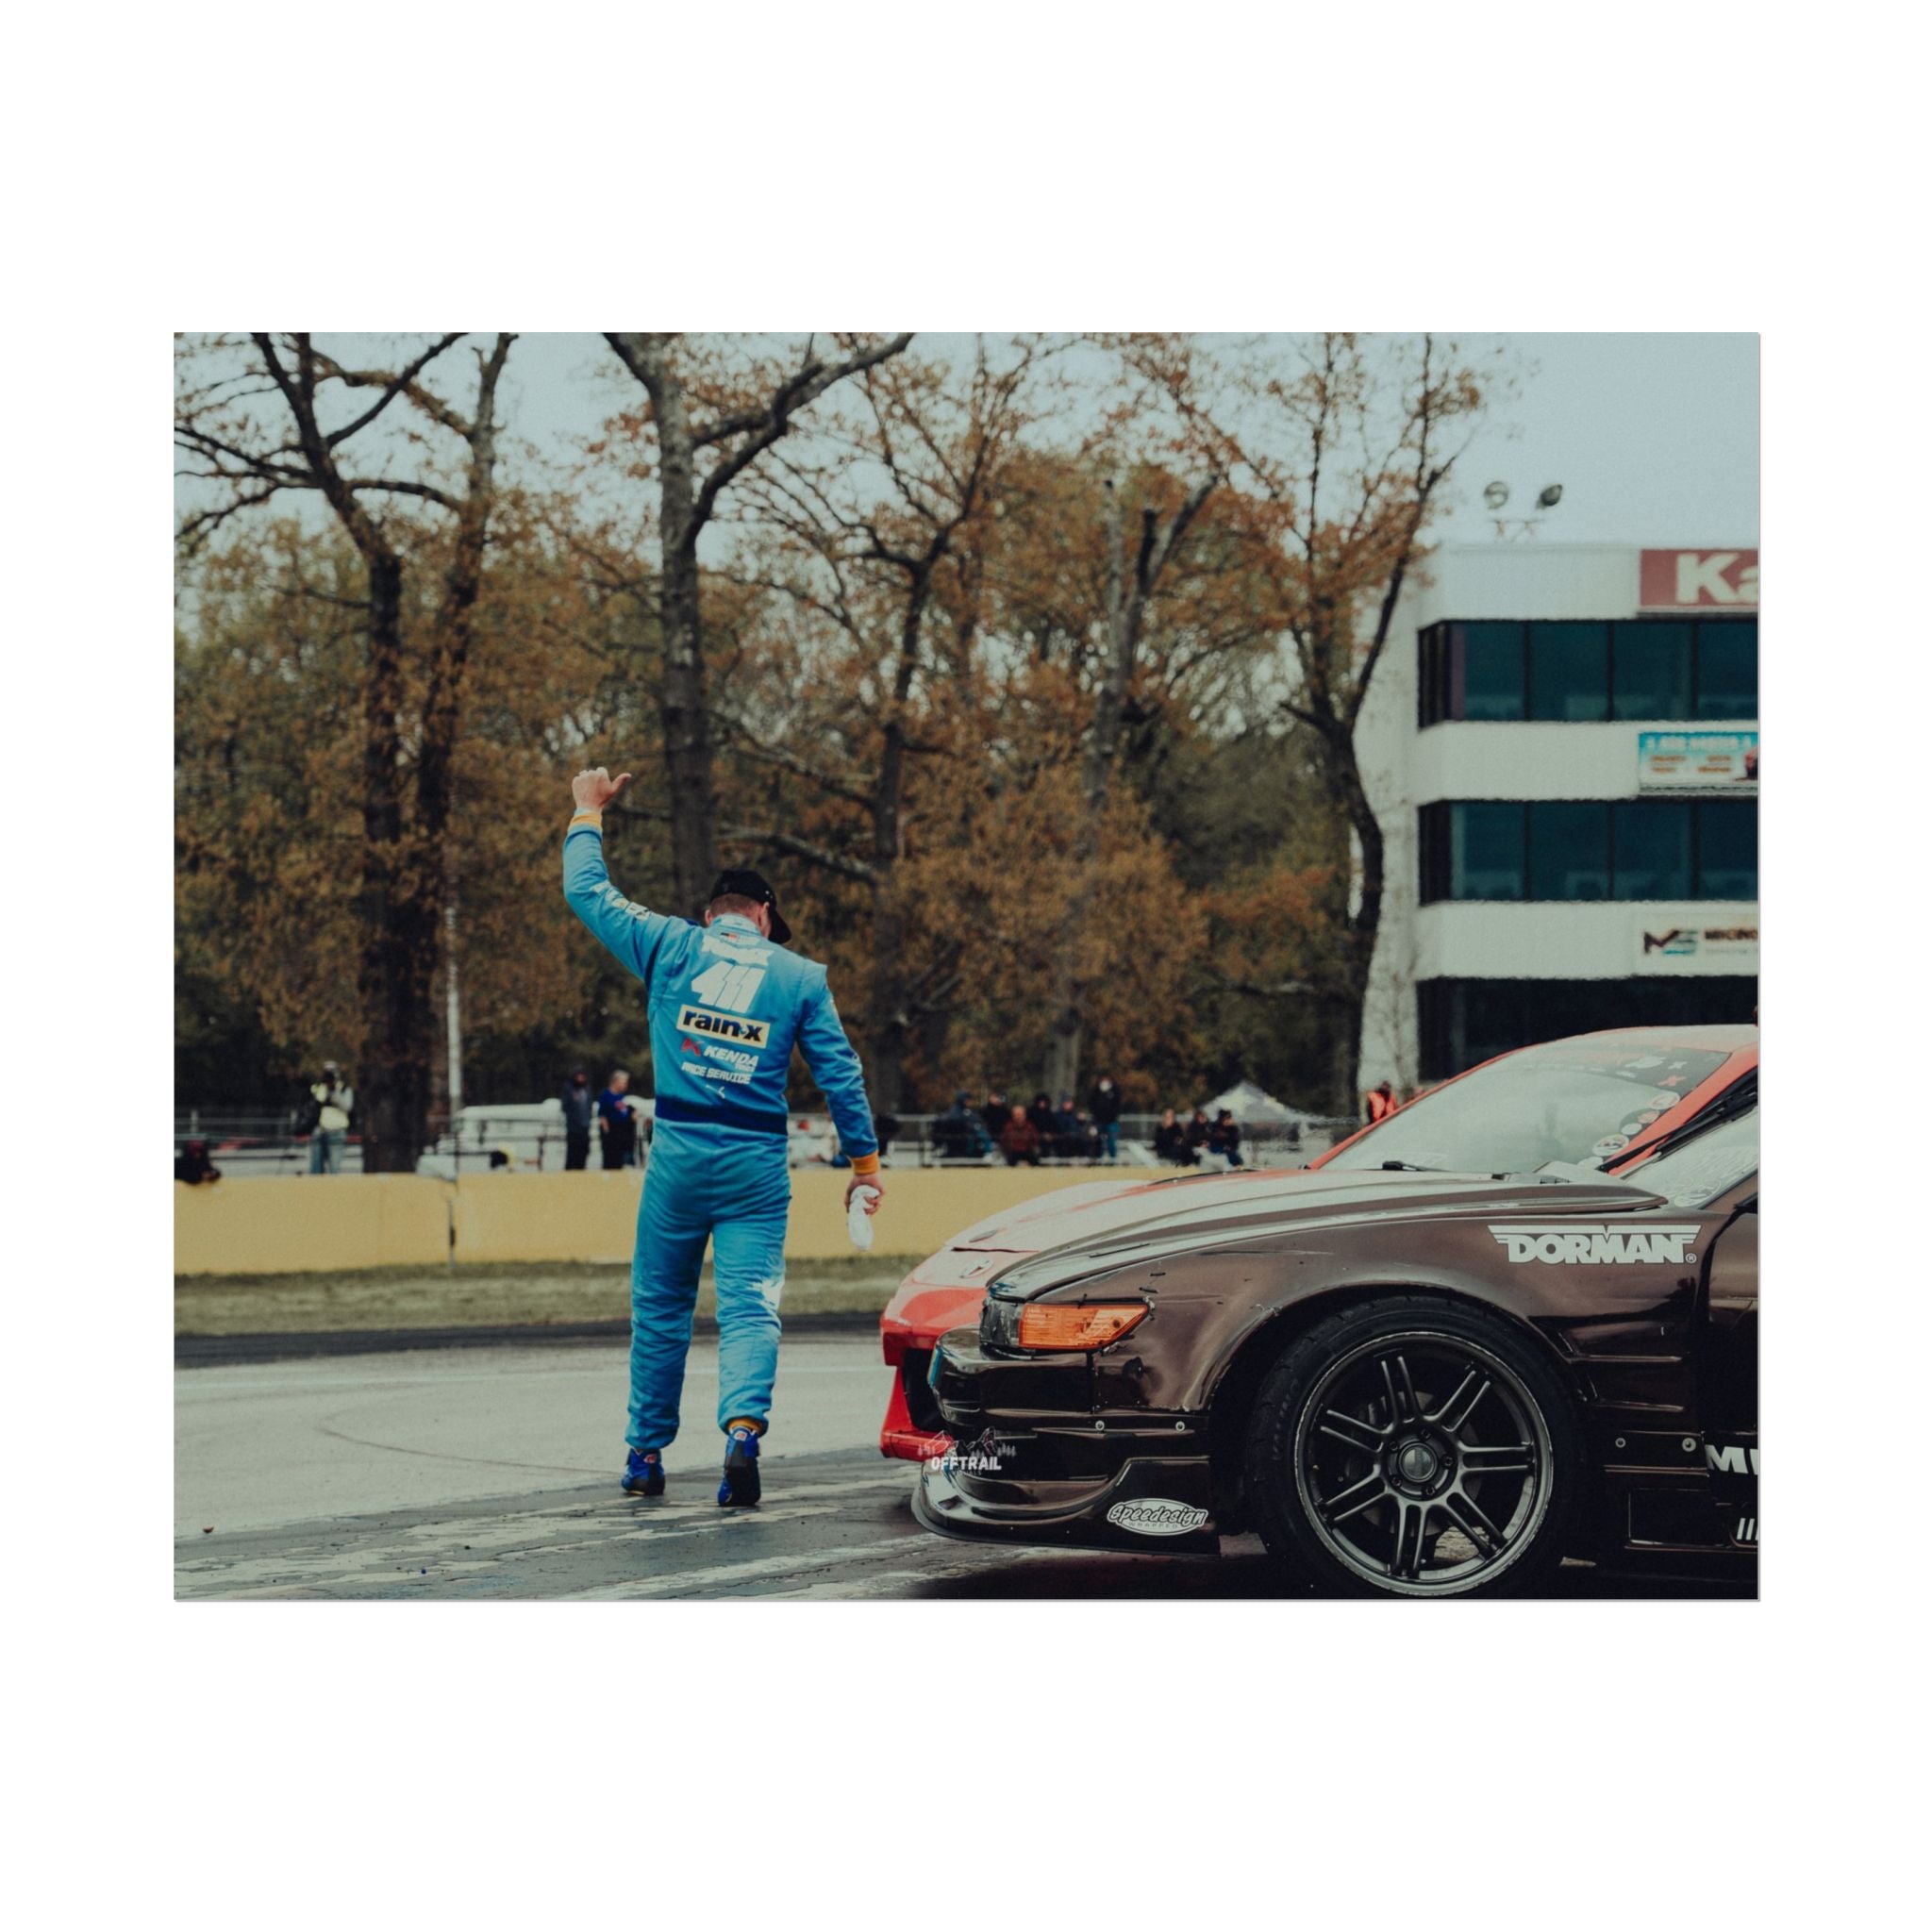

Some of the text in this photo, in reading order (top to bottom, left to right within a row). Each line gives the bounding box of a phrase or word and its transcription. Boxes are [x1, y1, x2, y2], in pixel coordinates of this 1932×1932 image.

[704, 1045, 758, 1068] KENDA
[1494, 1228, 1696, 1264] DORMAN
[1128, 1521, 1178, 1529] WRAPPED
